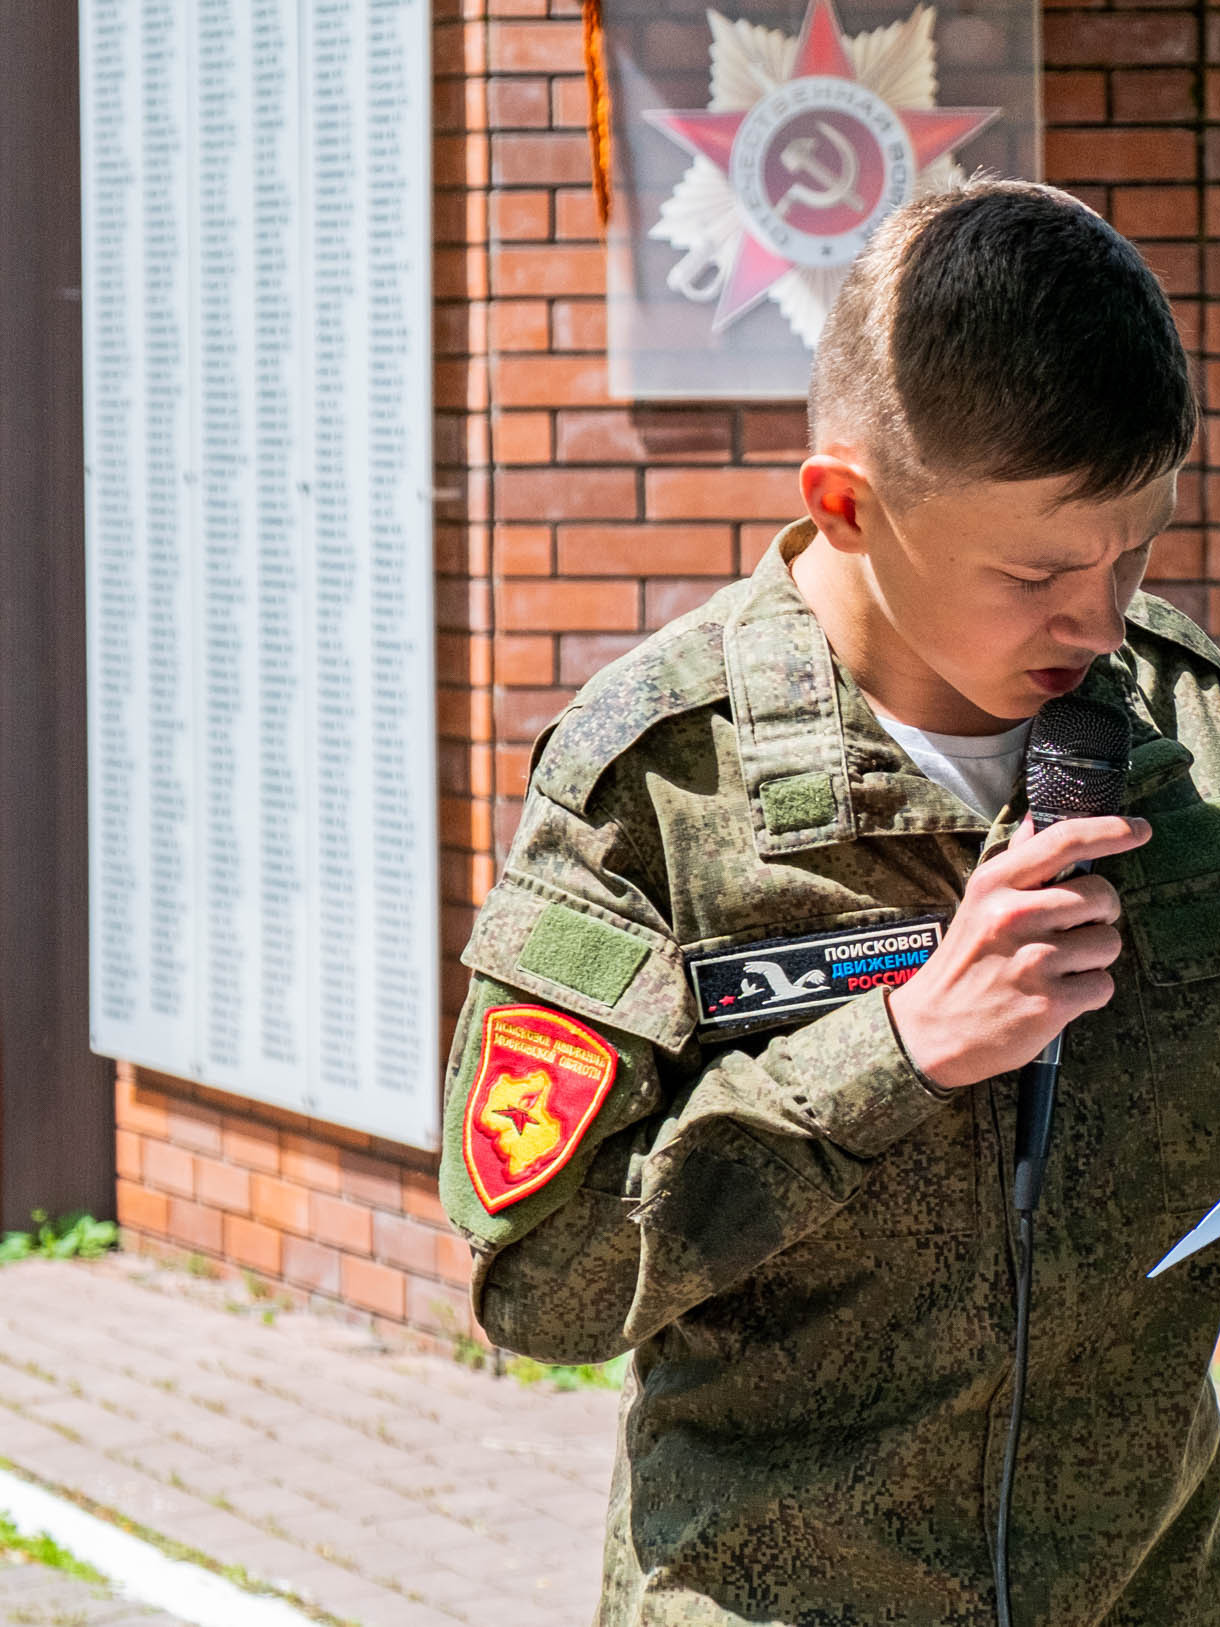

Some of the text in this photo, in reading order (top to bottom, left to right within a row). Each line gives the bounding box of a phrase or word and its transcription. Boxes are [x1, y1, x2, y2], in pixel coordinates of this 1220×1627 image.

[824, 932, 934, 962] ПОИСКОВОЕ
[832, 949, 929, 979] ДВИЖЕНИЕ
[559, 1055, 602, 1081] ОБЛАСТИ
